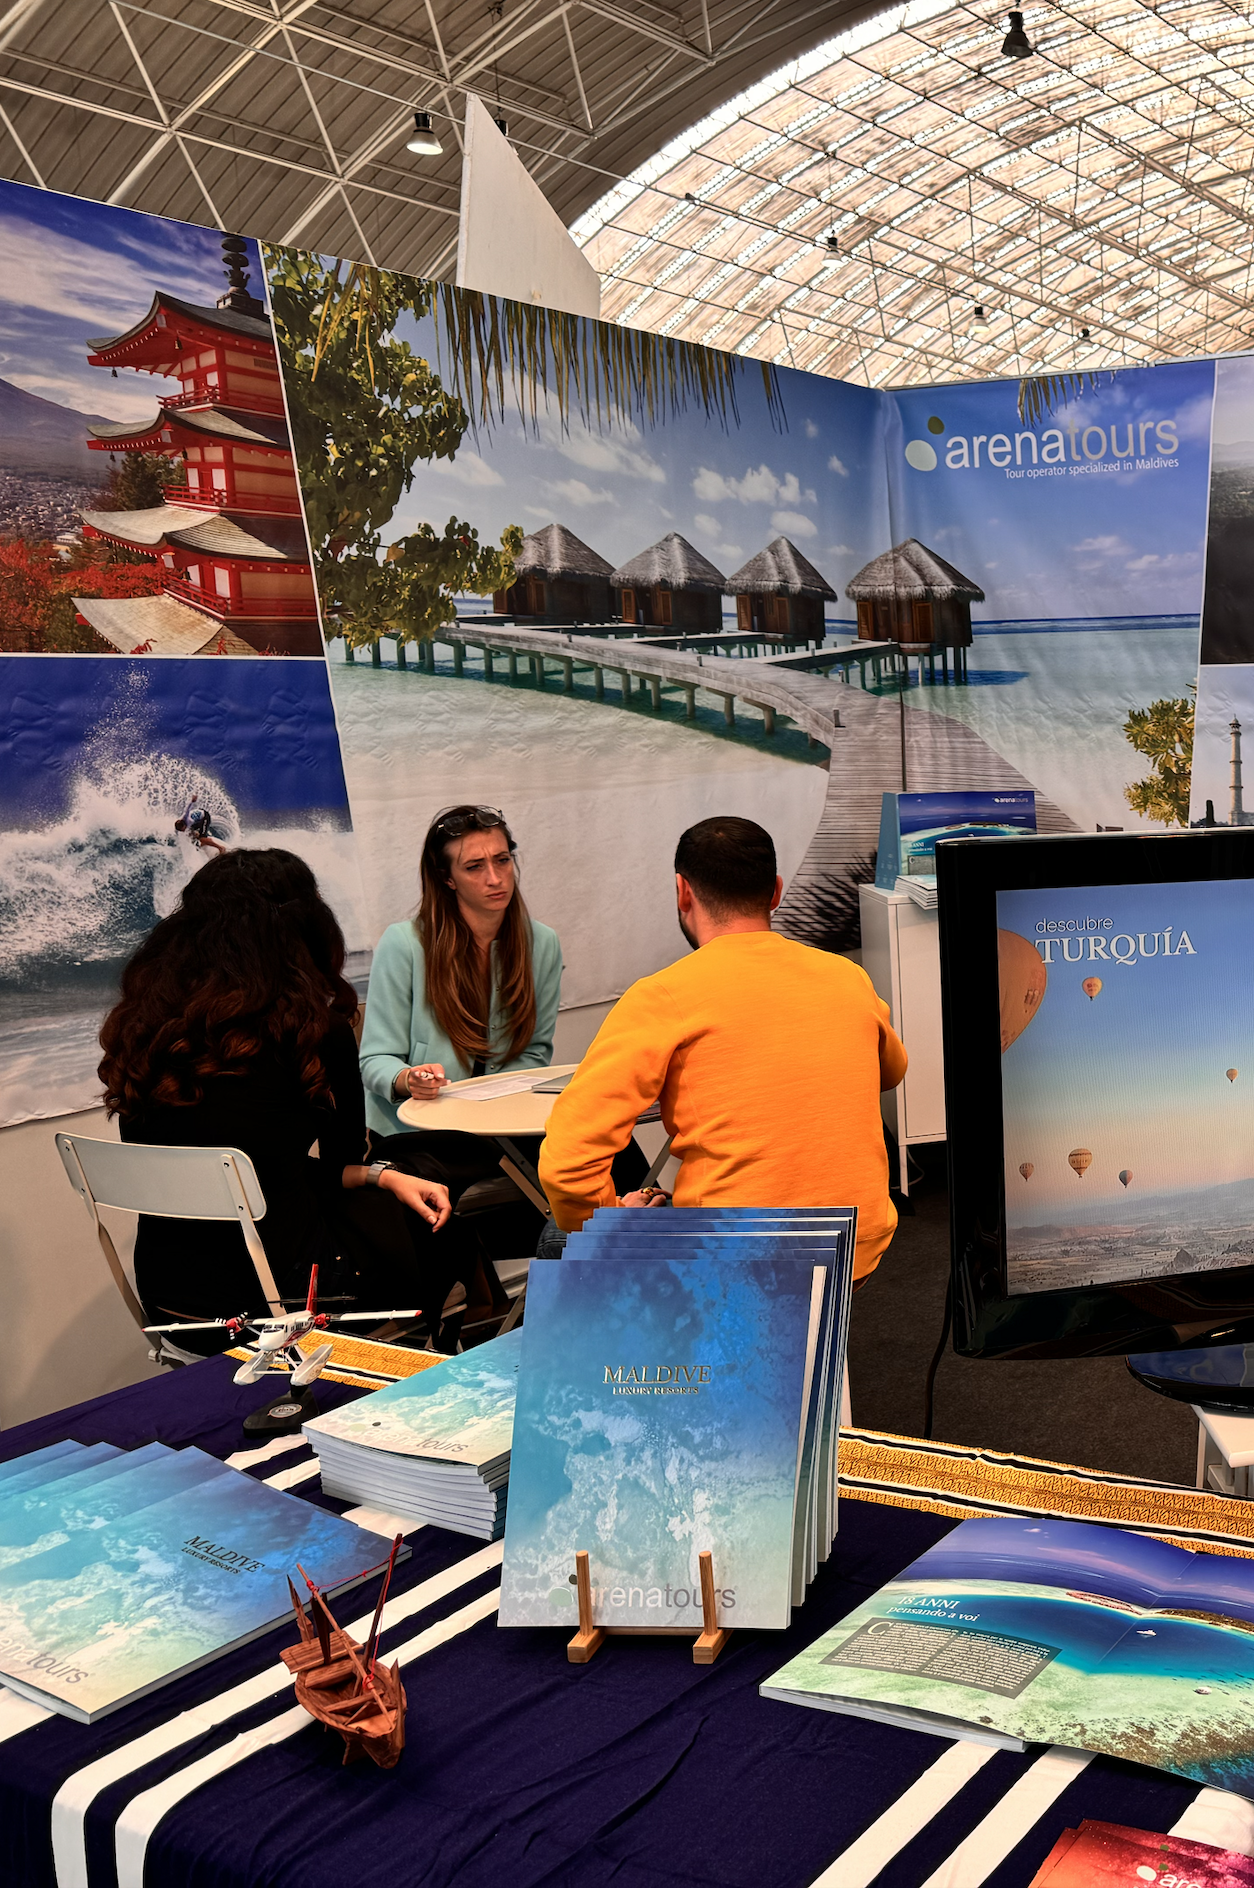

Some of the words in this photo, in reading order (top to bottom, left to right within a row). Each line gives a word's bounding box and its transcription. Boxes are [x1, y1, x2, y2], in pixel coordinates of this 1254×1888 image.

[945, 419, 1180, 469] arenatours
[1004, 468, 1025, 479] Tour
[1026, 465, 1066, 479] operator
[1068, 460, 1120, 476] specialized
[1123, 459, 1132, 470] in
[1135, 457, 1179, 470] Maldives
[1035, 916, 1113, 933] descubre
[1035, 926, 1197, 965] TURQUÍA
[602, 1365, 711, 1384] MALDIVE
[612, 1387, 652, 1395] LUXURY
[654, 1387, 699, 1395] RESORTS
[181, 1547, 211, 1562] LUXURY
[208, 1558, 241, 1574] RESORTS
[184, 1535, 265, 1572] MALDIVE
[898, 1596, 916, 1605] 18
[914, 1598, 960, 1609] ANNI
[886, 1606, 946, 1617] pensando
[959, 1613, 980, 1621] voi
